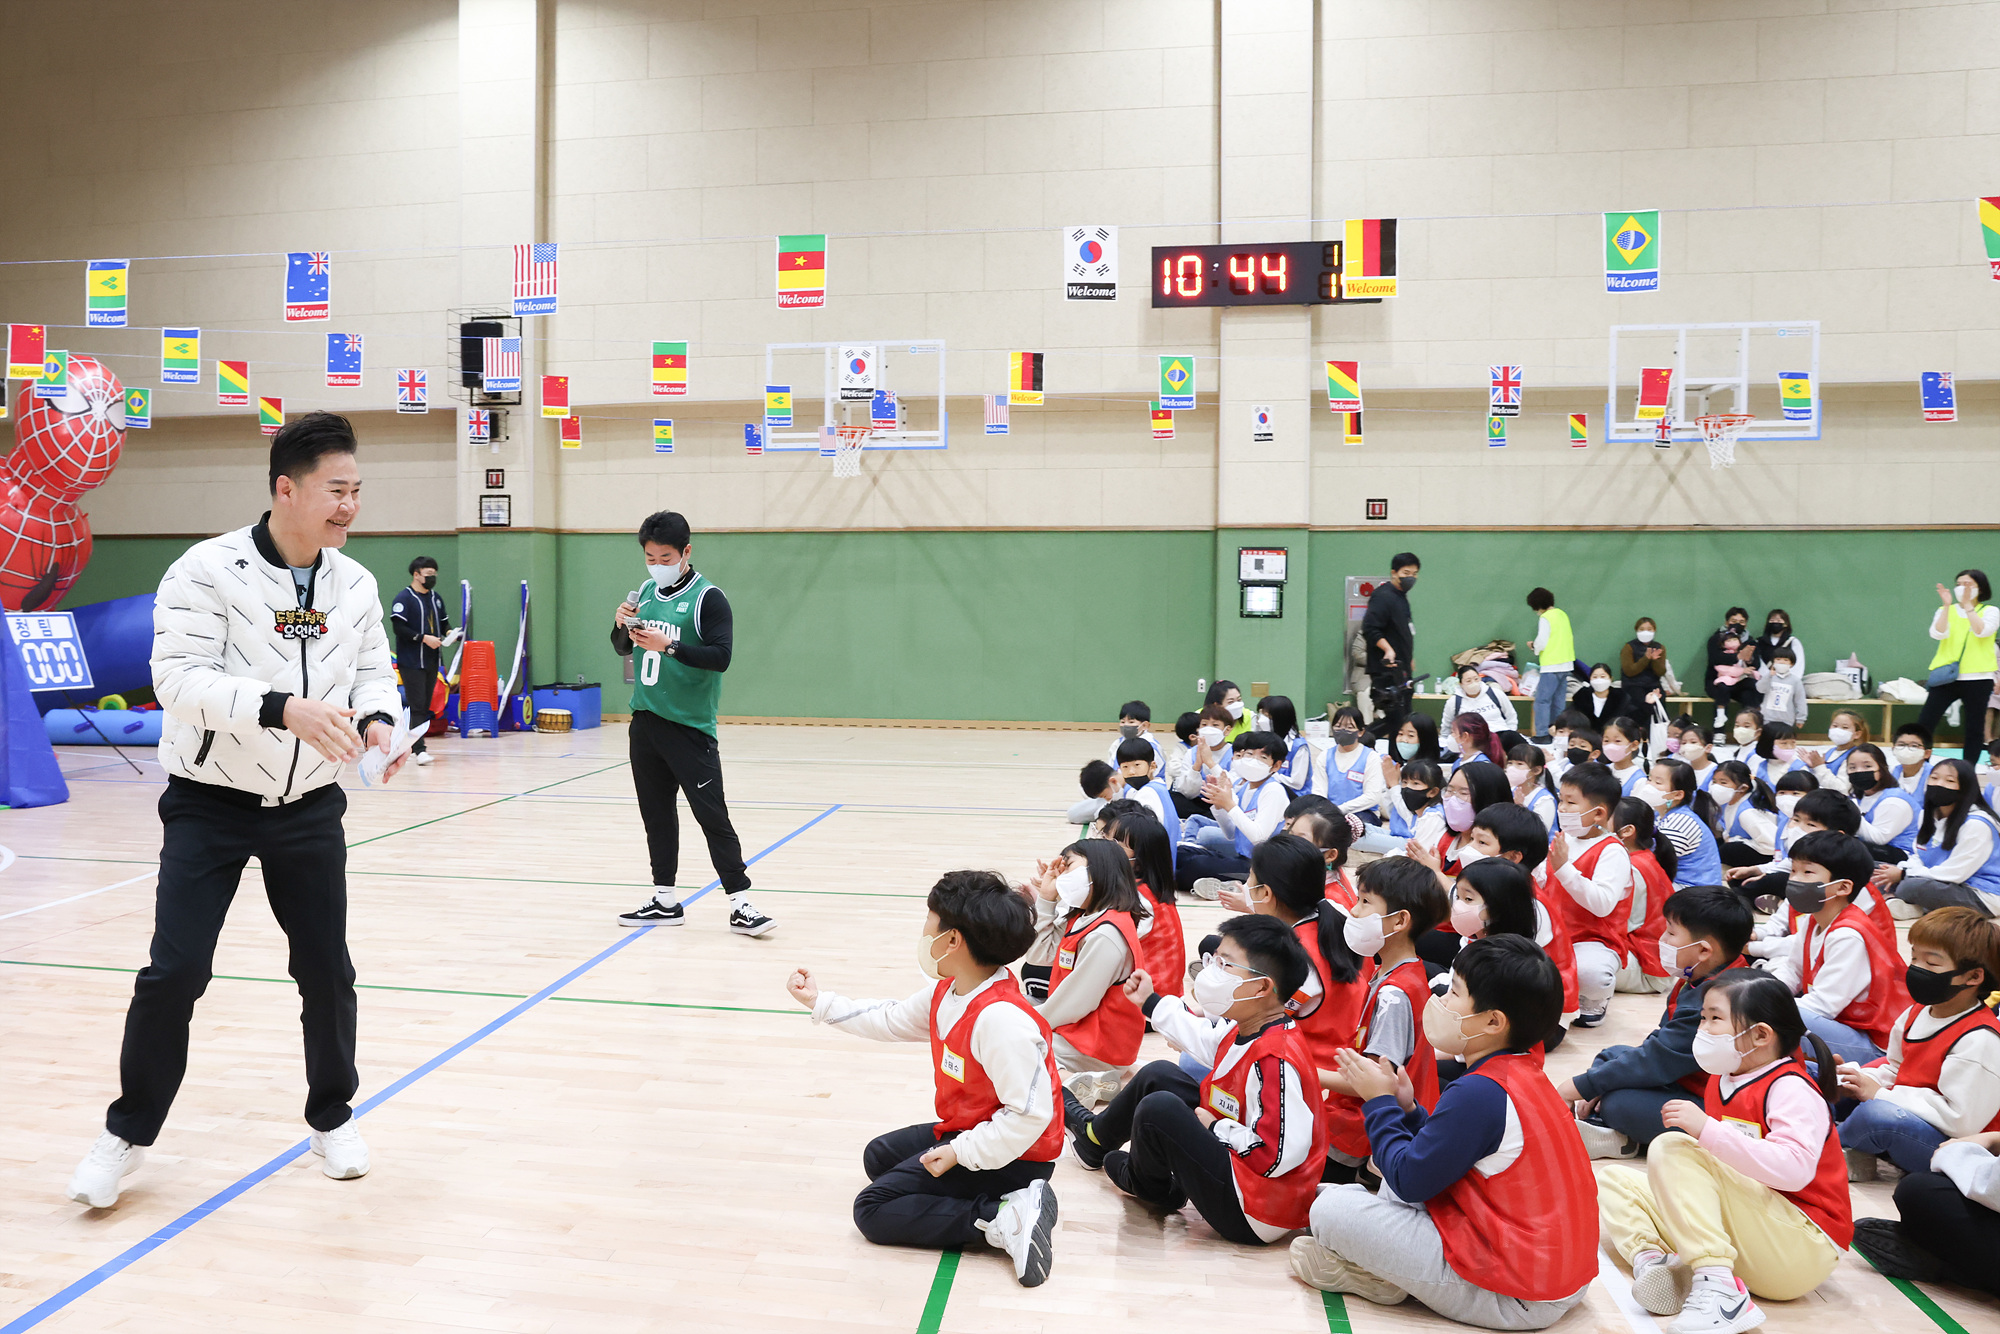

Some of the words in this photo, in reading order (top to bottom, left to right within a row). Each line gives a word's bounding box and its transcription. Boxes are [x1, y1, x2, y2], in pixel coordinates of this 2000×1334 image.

[1607, 277, 1657, 288] Welcome
[1068, 285, 1115, 296] Welcome
[1347, 283, 1396, 293] Welcome
[779, 294, 823, 304] Welcome
[515, 301, 556, 312] Welcome
[287, 307, 328, 318] Welcome
[164, 372, 198, 381] Welcome
[327, 377, 360, 385] Welcome
[486, 380, 519, 389] Welcome
[653, 384, 686, 393] Welcome
[841, 389, 874, 398] Welcome
[1161, 399, 1193, 407] Welcome
[276, 611, 327, 624] 도봉구청장
[284, 624, 320, 639] 오언석
[22, 641, 83, 684] 000
[640, 650, 661, 686] 0
